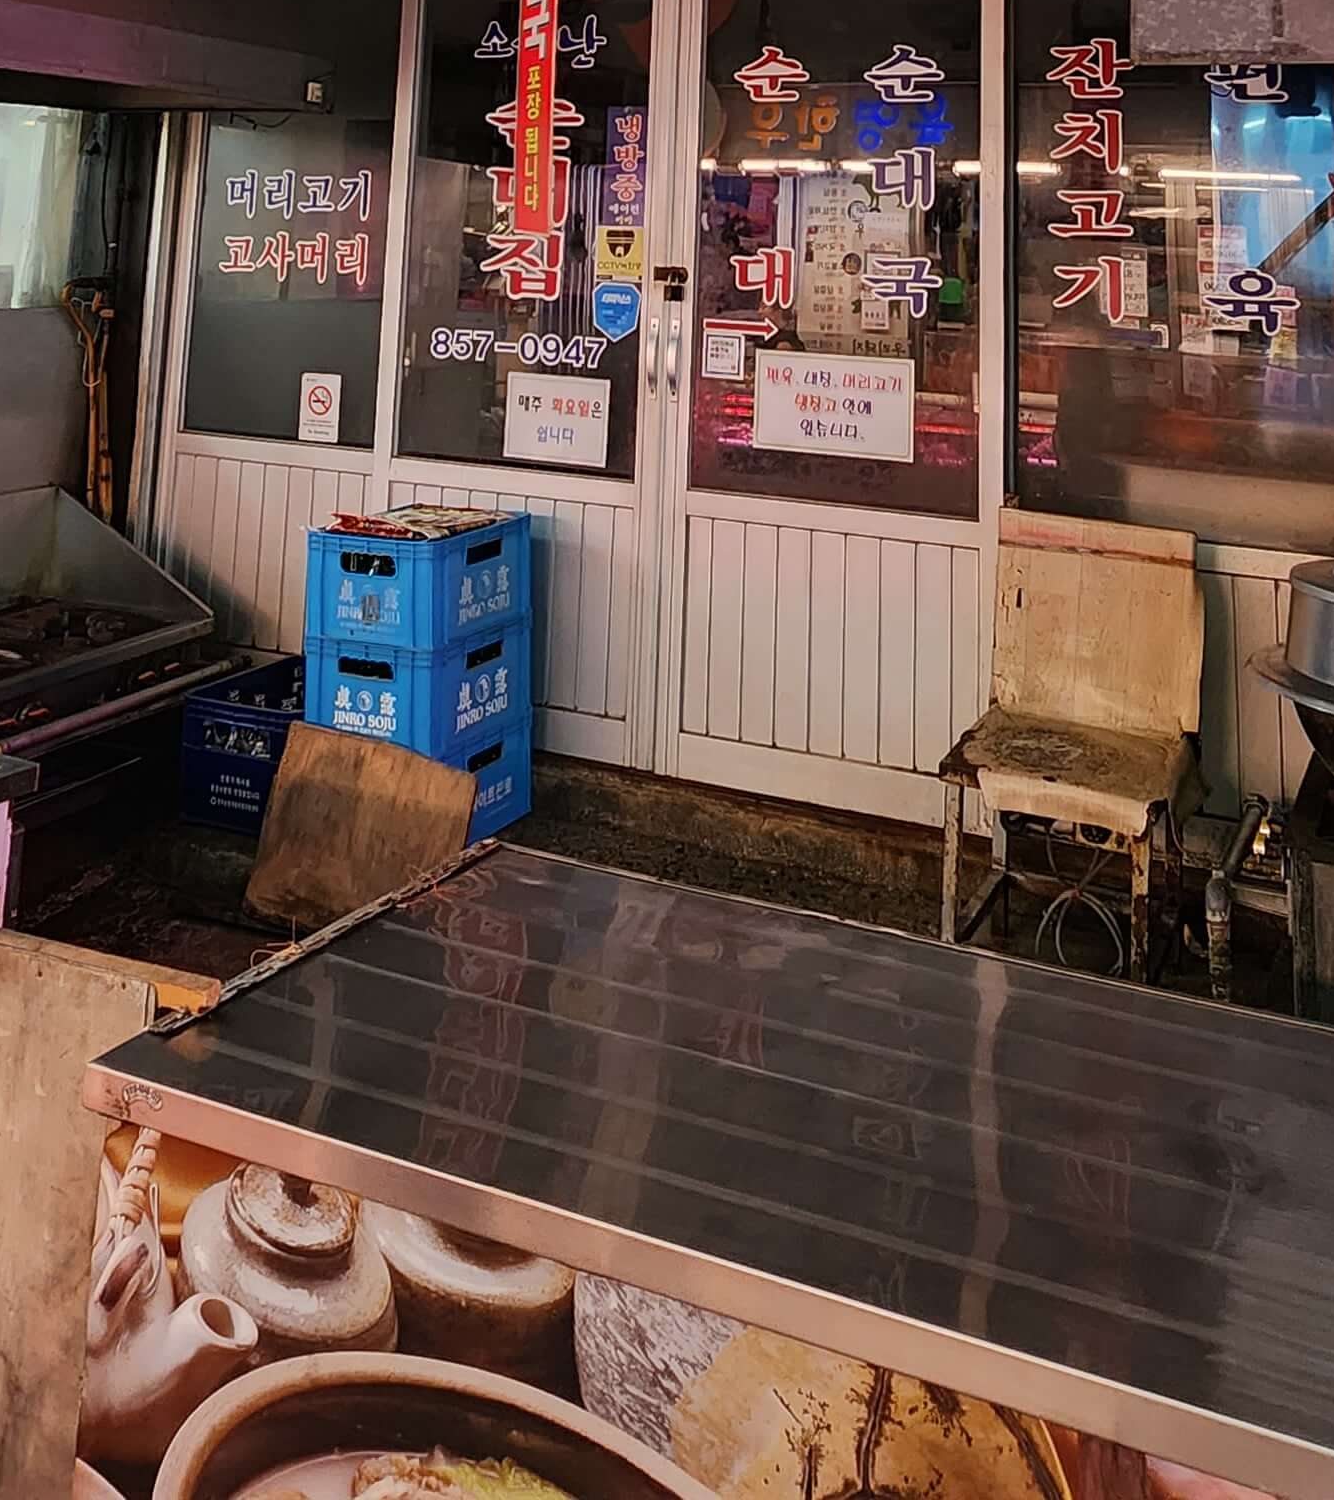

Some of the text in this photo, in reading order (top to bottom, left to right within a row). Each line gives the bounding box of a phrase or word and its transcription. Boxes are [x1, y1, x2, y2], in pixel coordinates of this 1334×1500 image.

[475, 15, 608, 68] 소난
[526, 65, 543, 121] 포장
[610, 114, 645, 202] 냉방중
[1046, 38, 1135, 323] 잔치고기
[226, 168, 373, 222] 머리고기
[218, 231, 371, 285] 고사머리
[430, 328, 607, 368] 857-0947
[518, 394, 543, 413] 매주
[333, 710, 366, 727] JINRO
[367, 715, 397, 732] SOJU
[456, 694, 509, 733] JINRO SOJU
